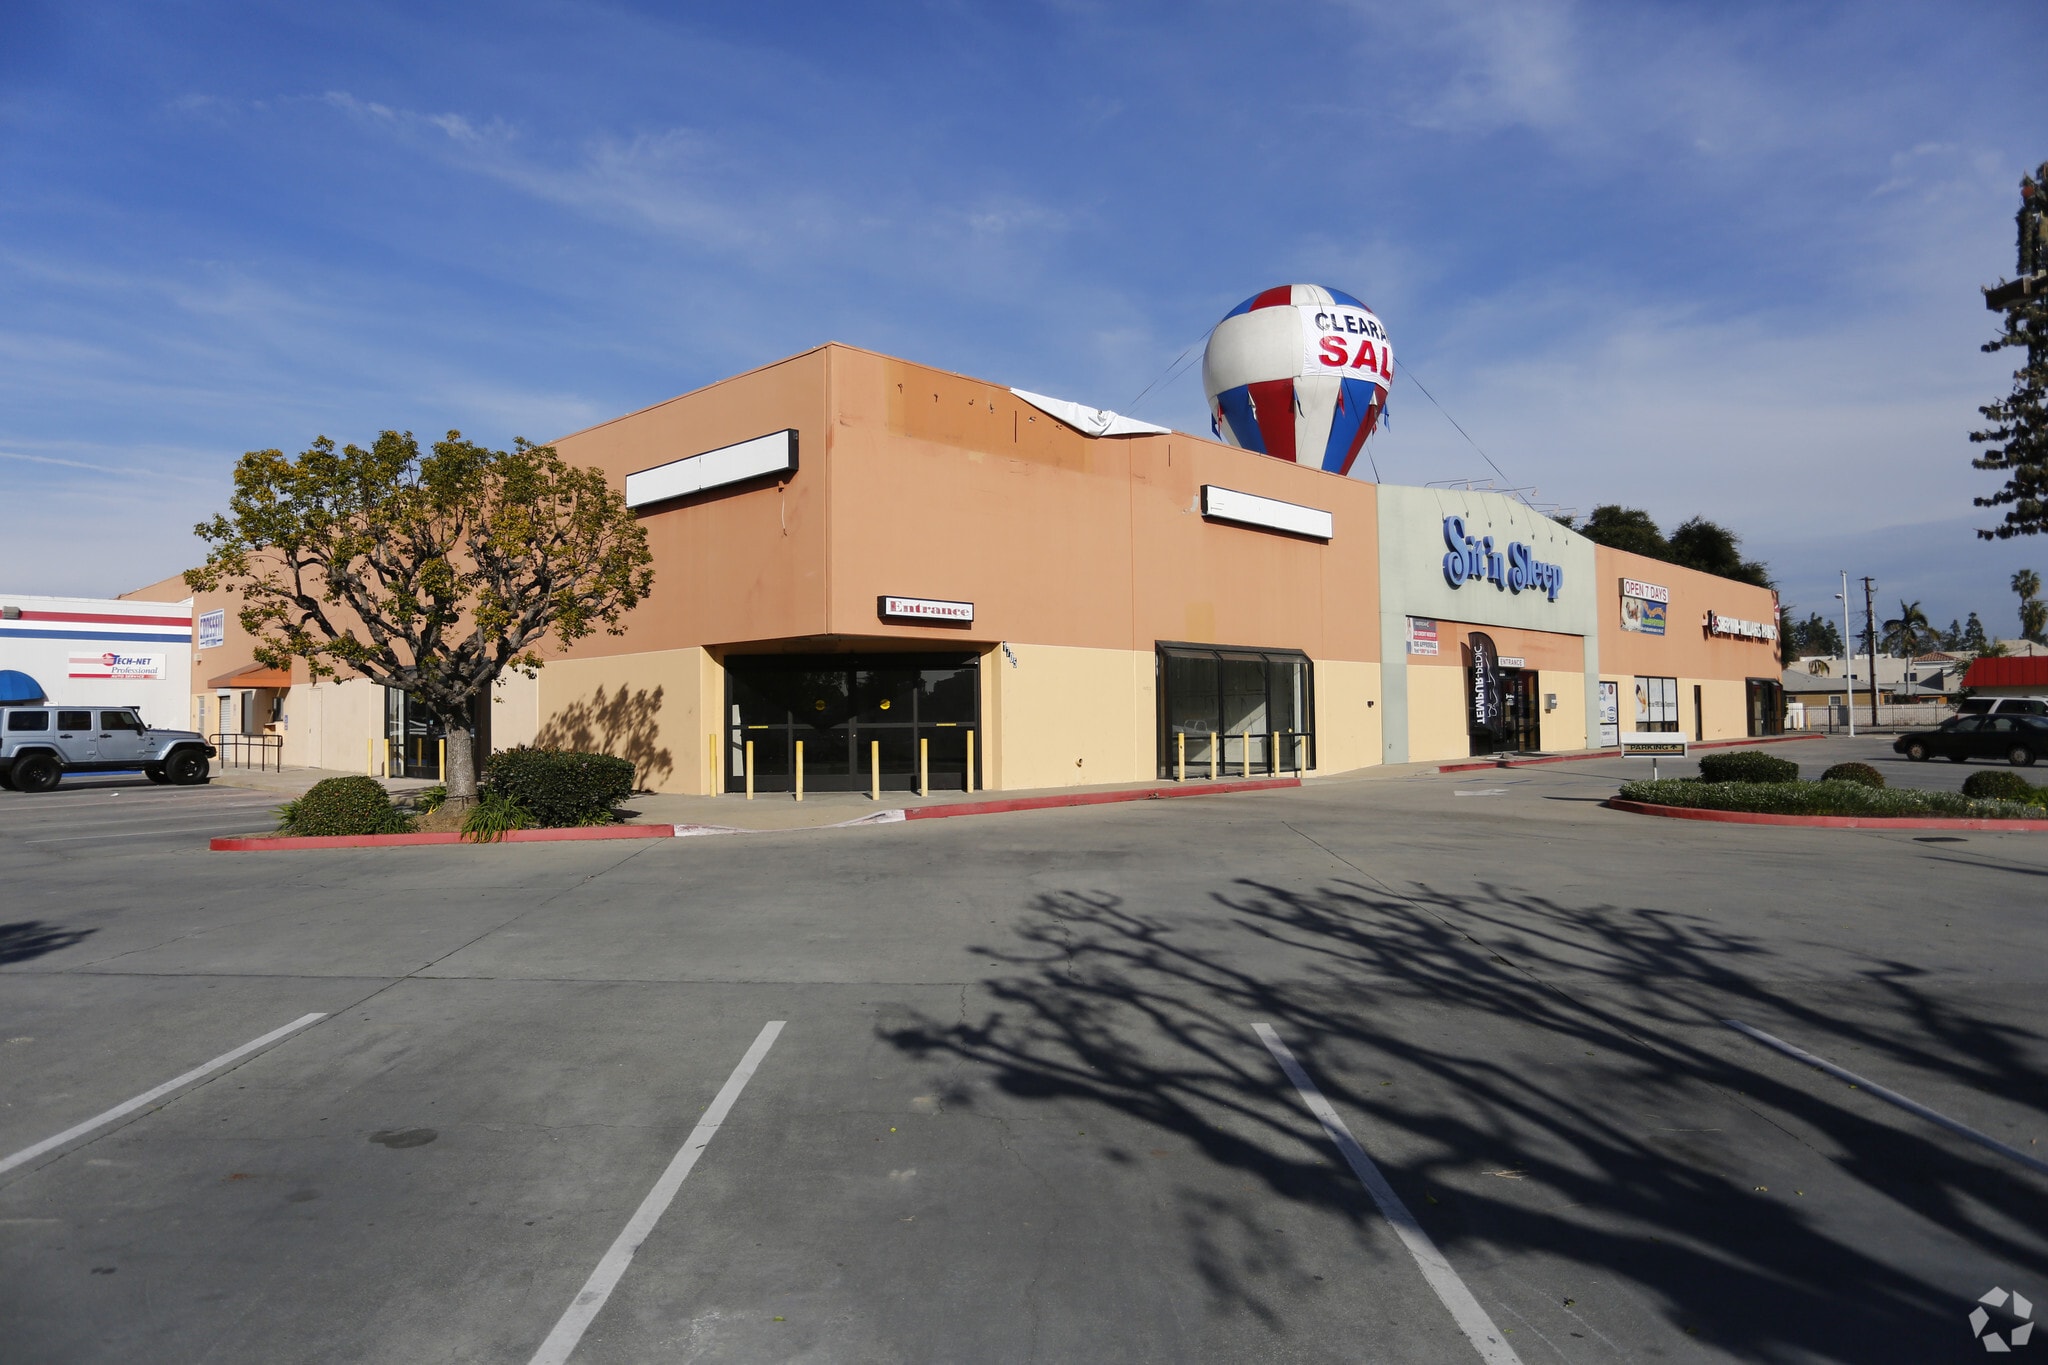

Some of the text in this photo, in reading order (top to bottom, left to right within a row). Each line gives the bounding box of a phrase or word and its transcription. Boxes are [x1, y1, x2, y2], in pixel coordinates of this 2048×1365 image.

[1318, 335, 1394, 385] SAL
[1508, 541, 1564, 599] Sleep
[1625, 580, 1667, 601] OPEN 7 DAYS
[890, 601, 969, 616] Entrance
[112, 655, 152, 665] TECH-NET
[1500, 658, 1522, 666] ENTRANCE
[1630, 743, 1669, 751] PARKING
